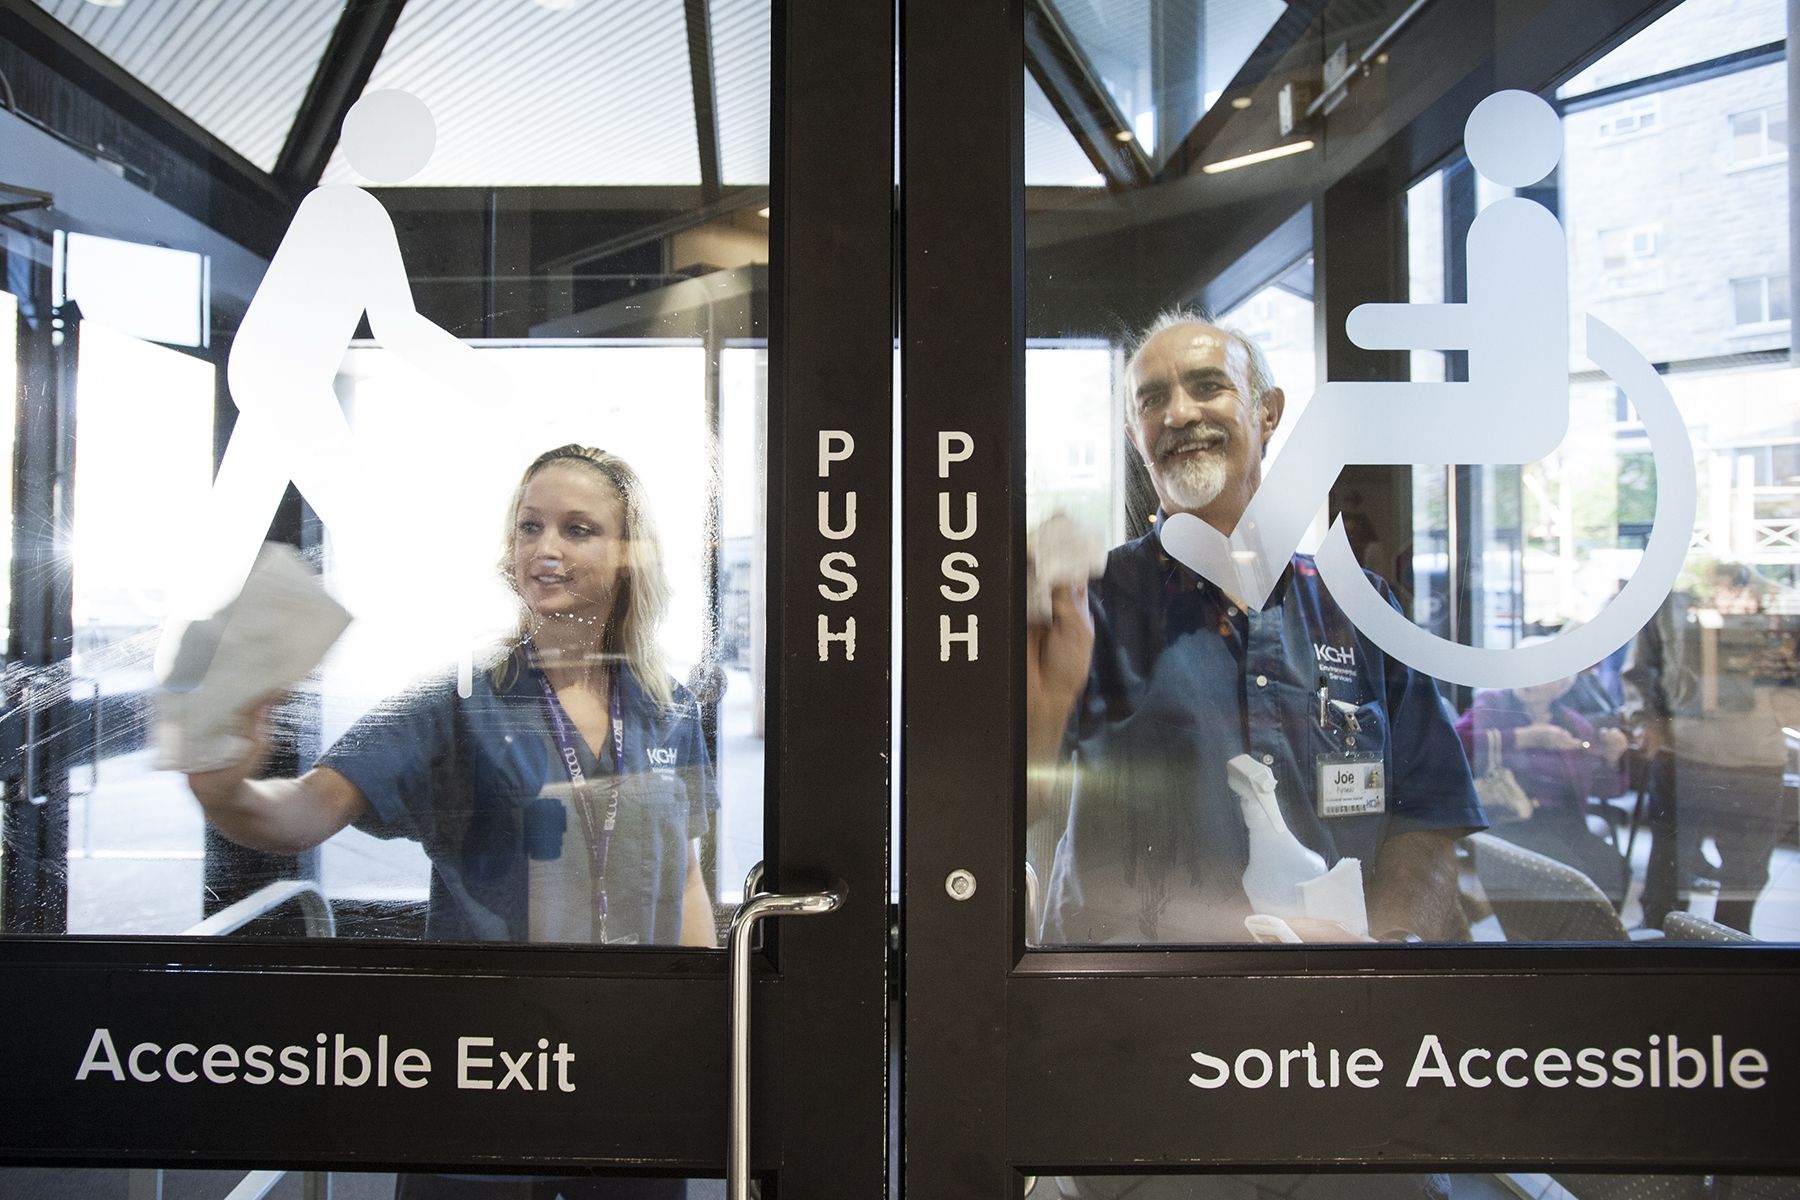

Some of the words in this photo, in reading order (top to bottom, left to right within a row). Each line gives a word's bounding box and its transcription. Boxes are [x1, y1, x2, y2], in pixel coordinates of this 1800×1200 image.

[818, 430, 858, 662] PUSH
[938, 431, 980, 662] PUSH
[1334, 770, 1354, 785] Joe
[75, 1029, 431, 1088] Accessible
[457, 1036, 576, 1092] Exit
[1189, 1041, 1384, 1089] Sortie
[1406, 1034, 1769, 1089] Accessible
